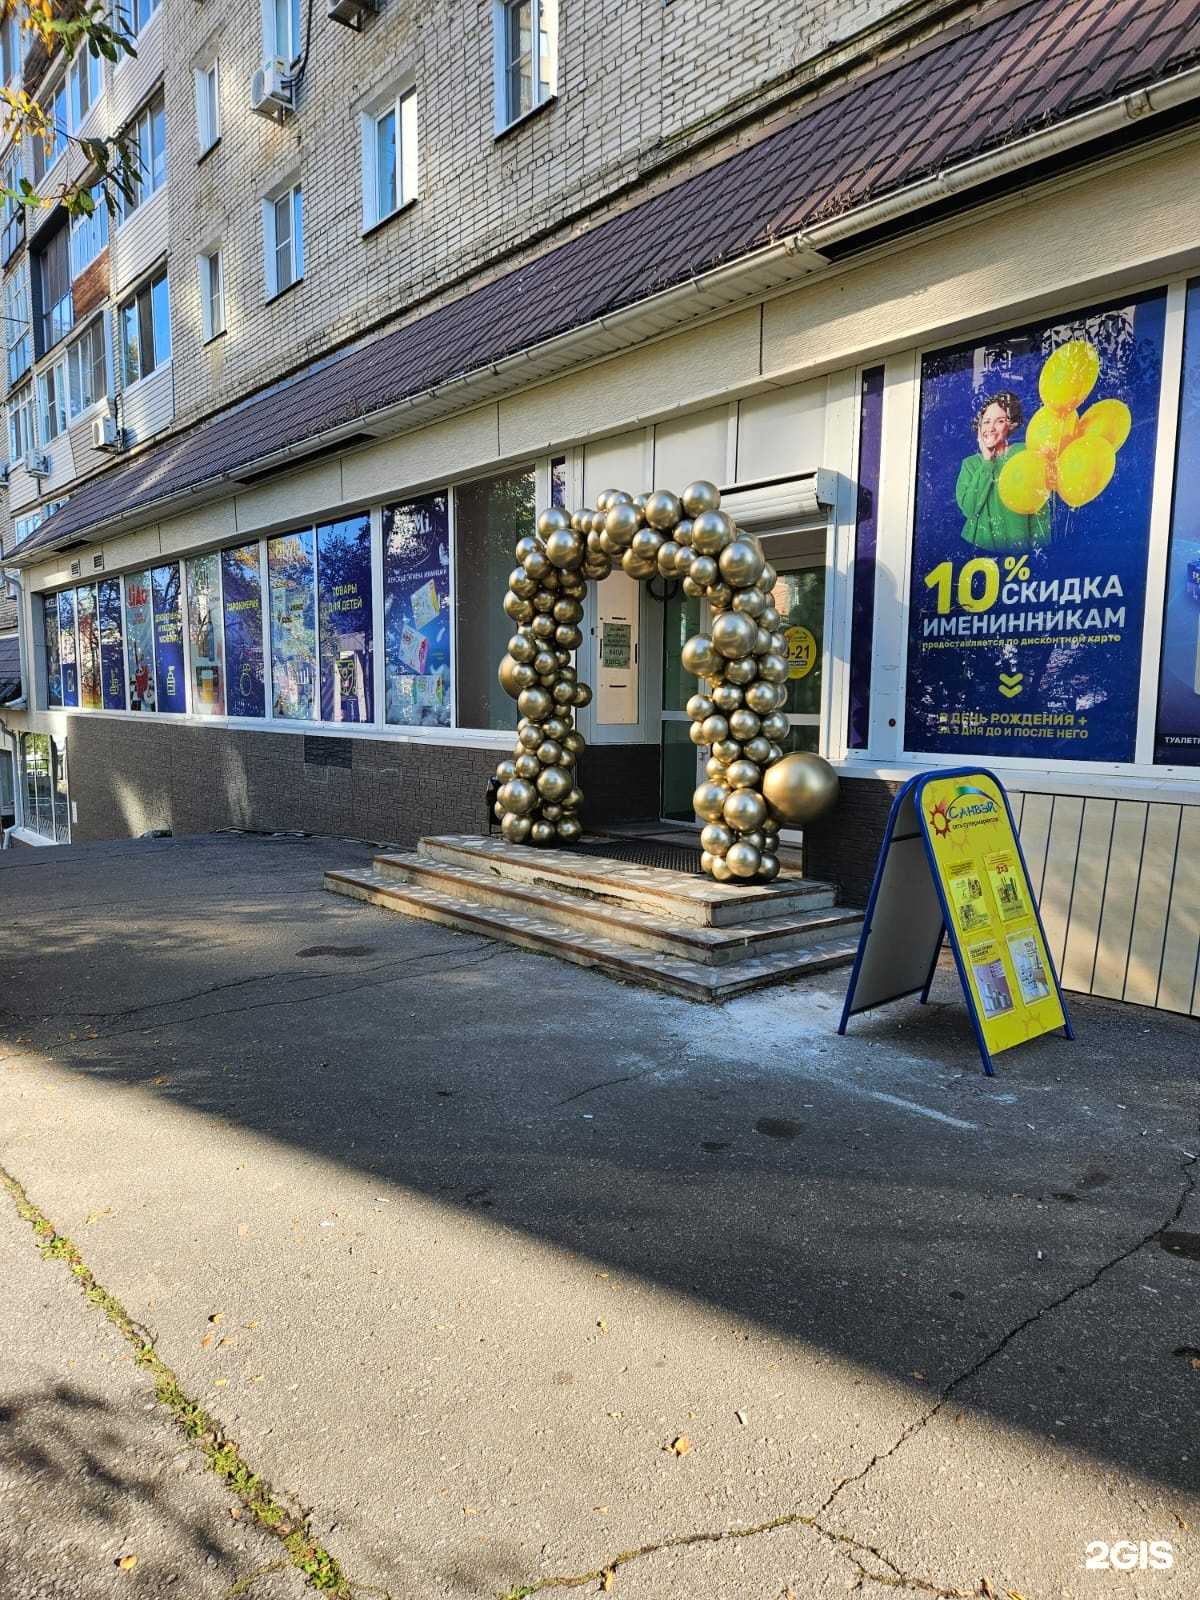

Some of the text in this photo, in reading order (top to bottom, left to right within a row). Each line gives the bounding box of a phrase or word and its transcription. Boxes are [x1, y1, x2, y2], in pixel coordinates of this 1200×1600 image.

[332, 583, 358, 596] ТОВАРЫ
[1002, 574, 1124, 605] СКИДКА
[341, 595, 363, 612] ДЕТЕЙ
[923, 606, 1126, 637] ИМЕНИННИКАМ
[921, 639, 1005, 650] предоставляется
[1007, 638, 1019, 647] по
[1021, 633, 1086, 646] дисконтной
[950, 711, 988, 725] ДЕНЬ
[991, 712, 1075, 726] РОЖДЕНИЯ
[961, 726, 984, 737] ДНЯ
[986, 726, 1002, 737] ДО
[1003, 727, 1012, 737] И
[1013, 728, 1055, 738] ПОСЛЕ
[1056, 728, 1089, 740] НЕГО
